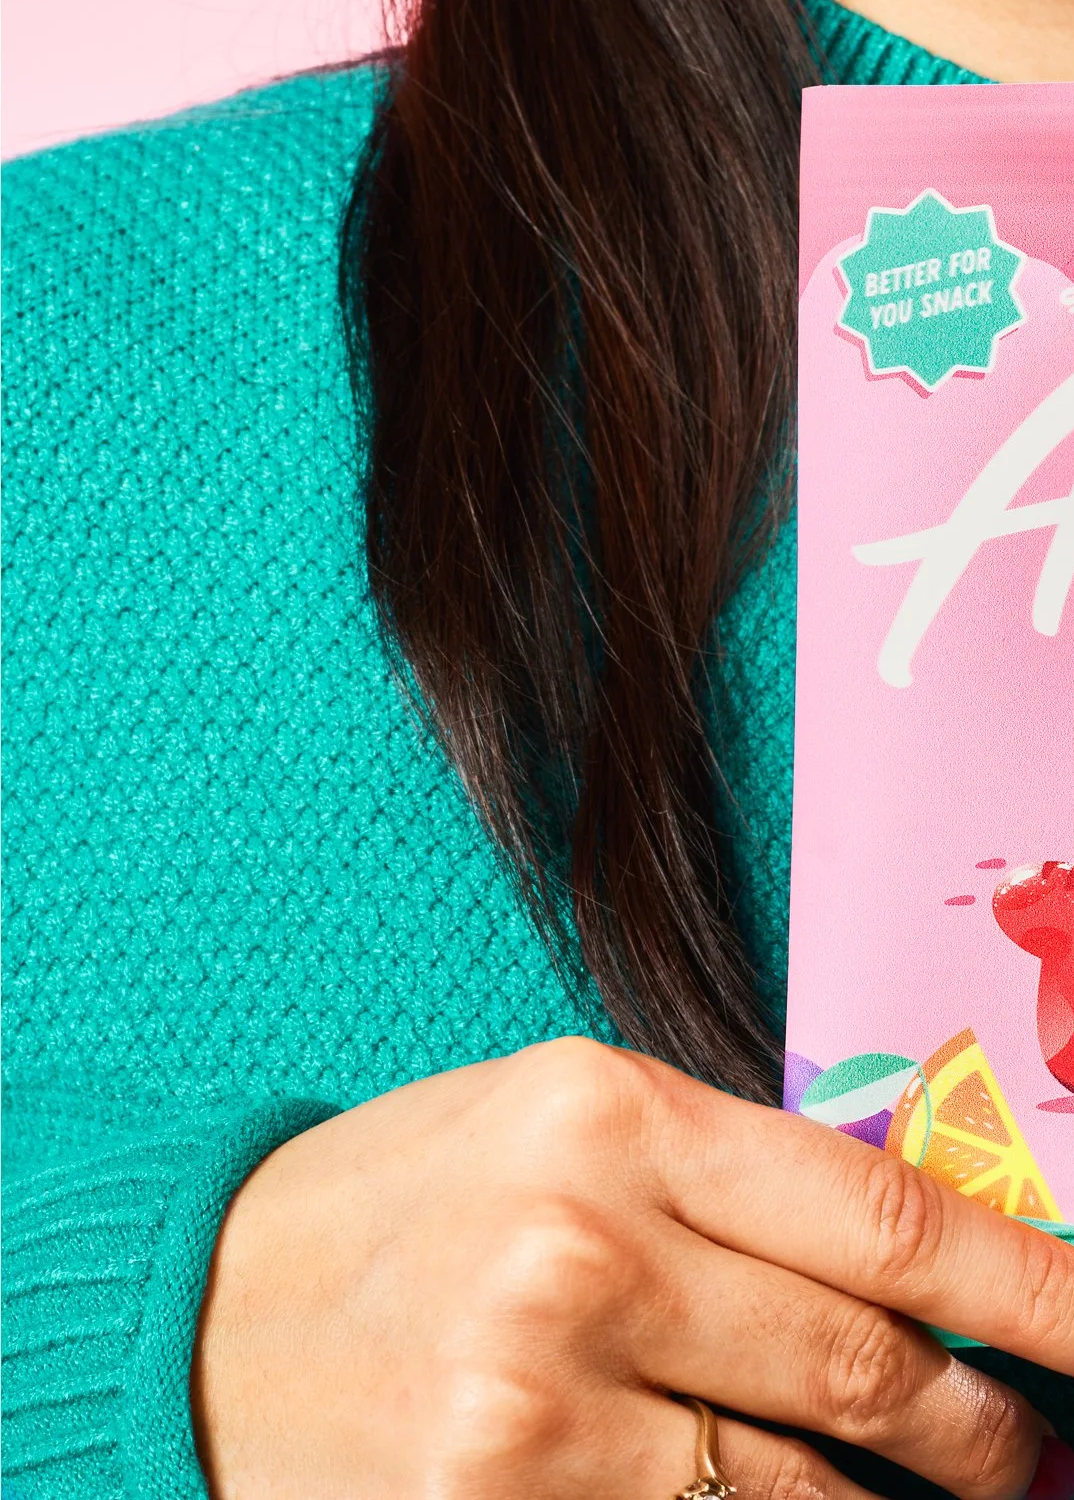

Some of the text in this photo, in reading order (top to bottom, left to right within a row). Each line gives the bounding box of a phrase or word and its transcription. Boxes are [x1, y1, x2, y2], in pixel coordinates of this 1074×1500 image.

[865, 247, 991, 297] BETTER FOR
[870, 280, 992, 329] YOU SNACK
